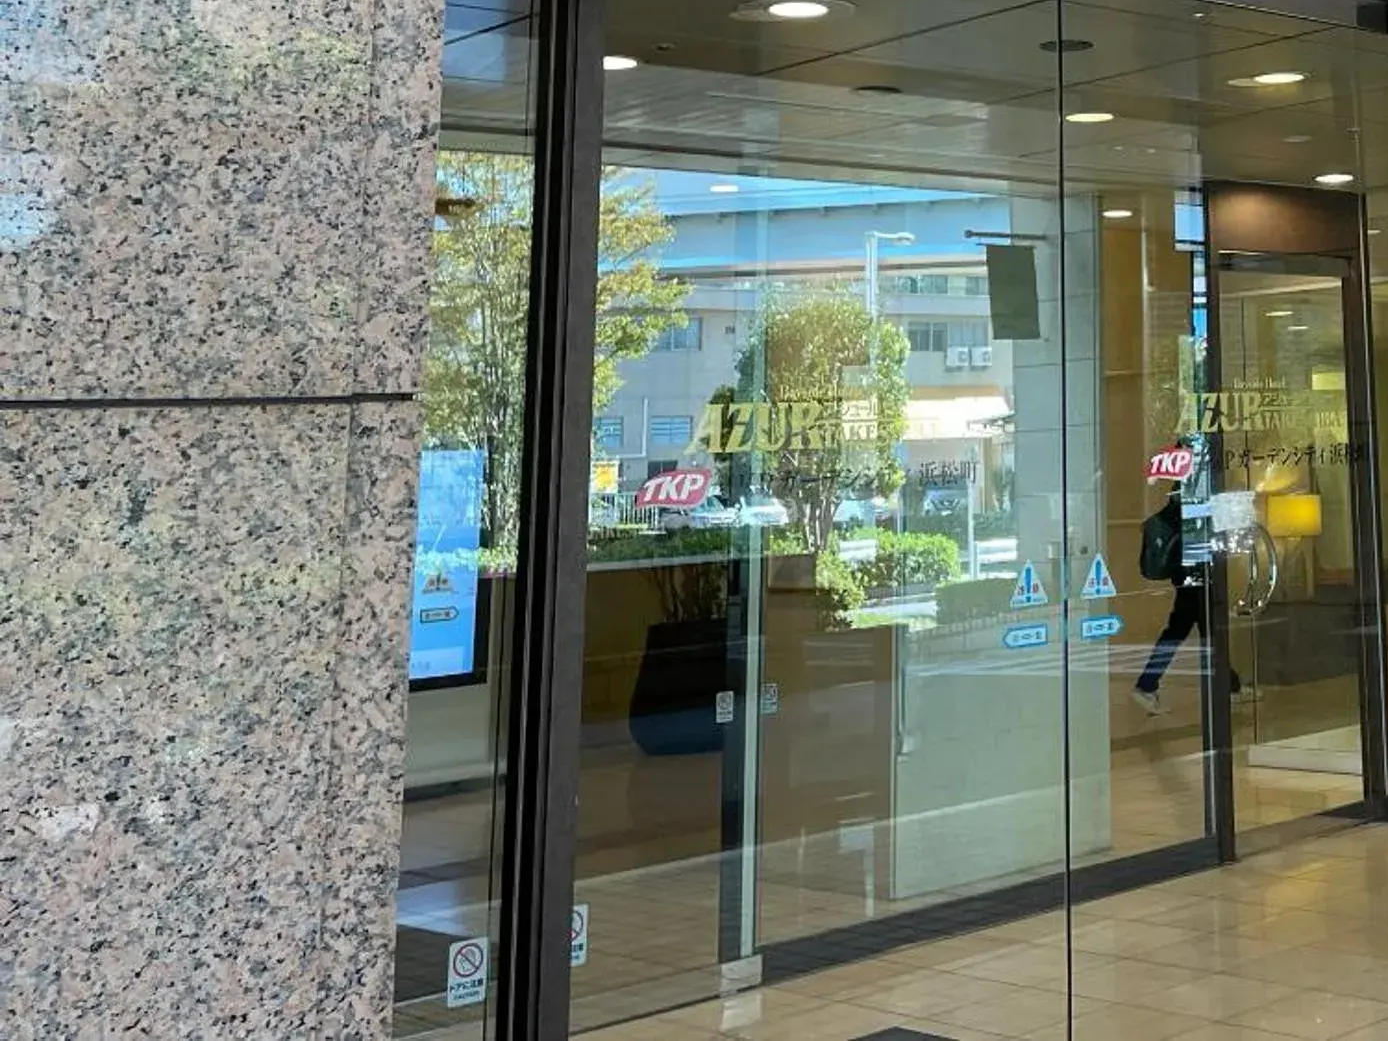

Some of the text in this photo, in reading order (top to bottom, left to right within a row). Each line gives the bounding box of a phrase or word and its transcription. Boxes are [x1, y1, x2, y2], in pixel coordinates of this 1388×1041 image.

[684, 402, 824, 454] AZUR
[1175, 392, 1265, 434] AZUR
[1150, 450, 1191, 474] TKP
[643, 473, 704, 501] TKP
